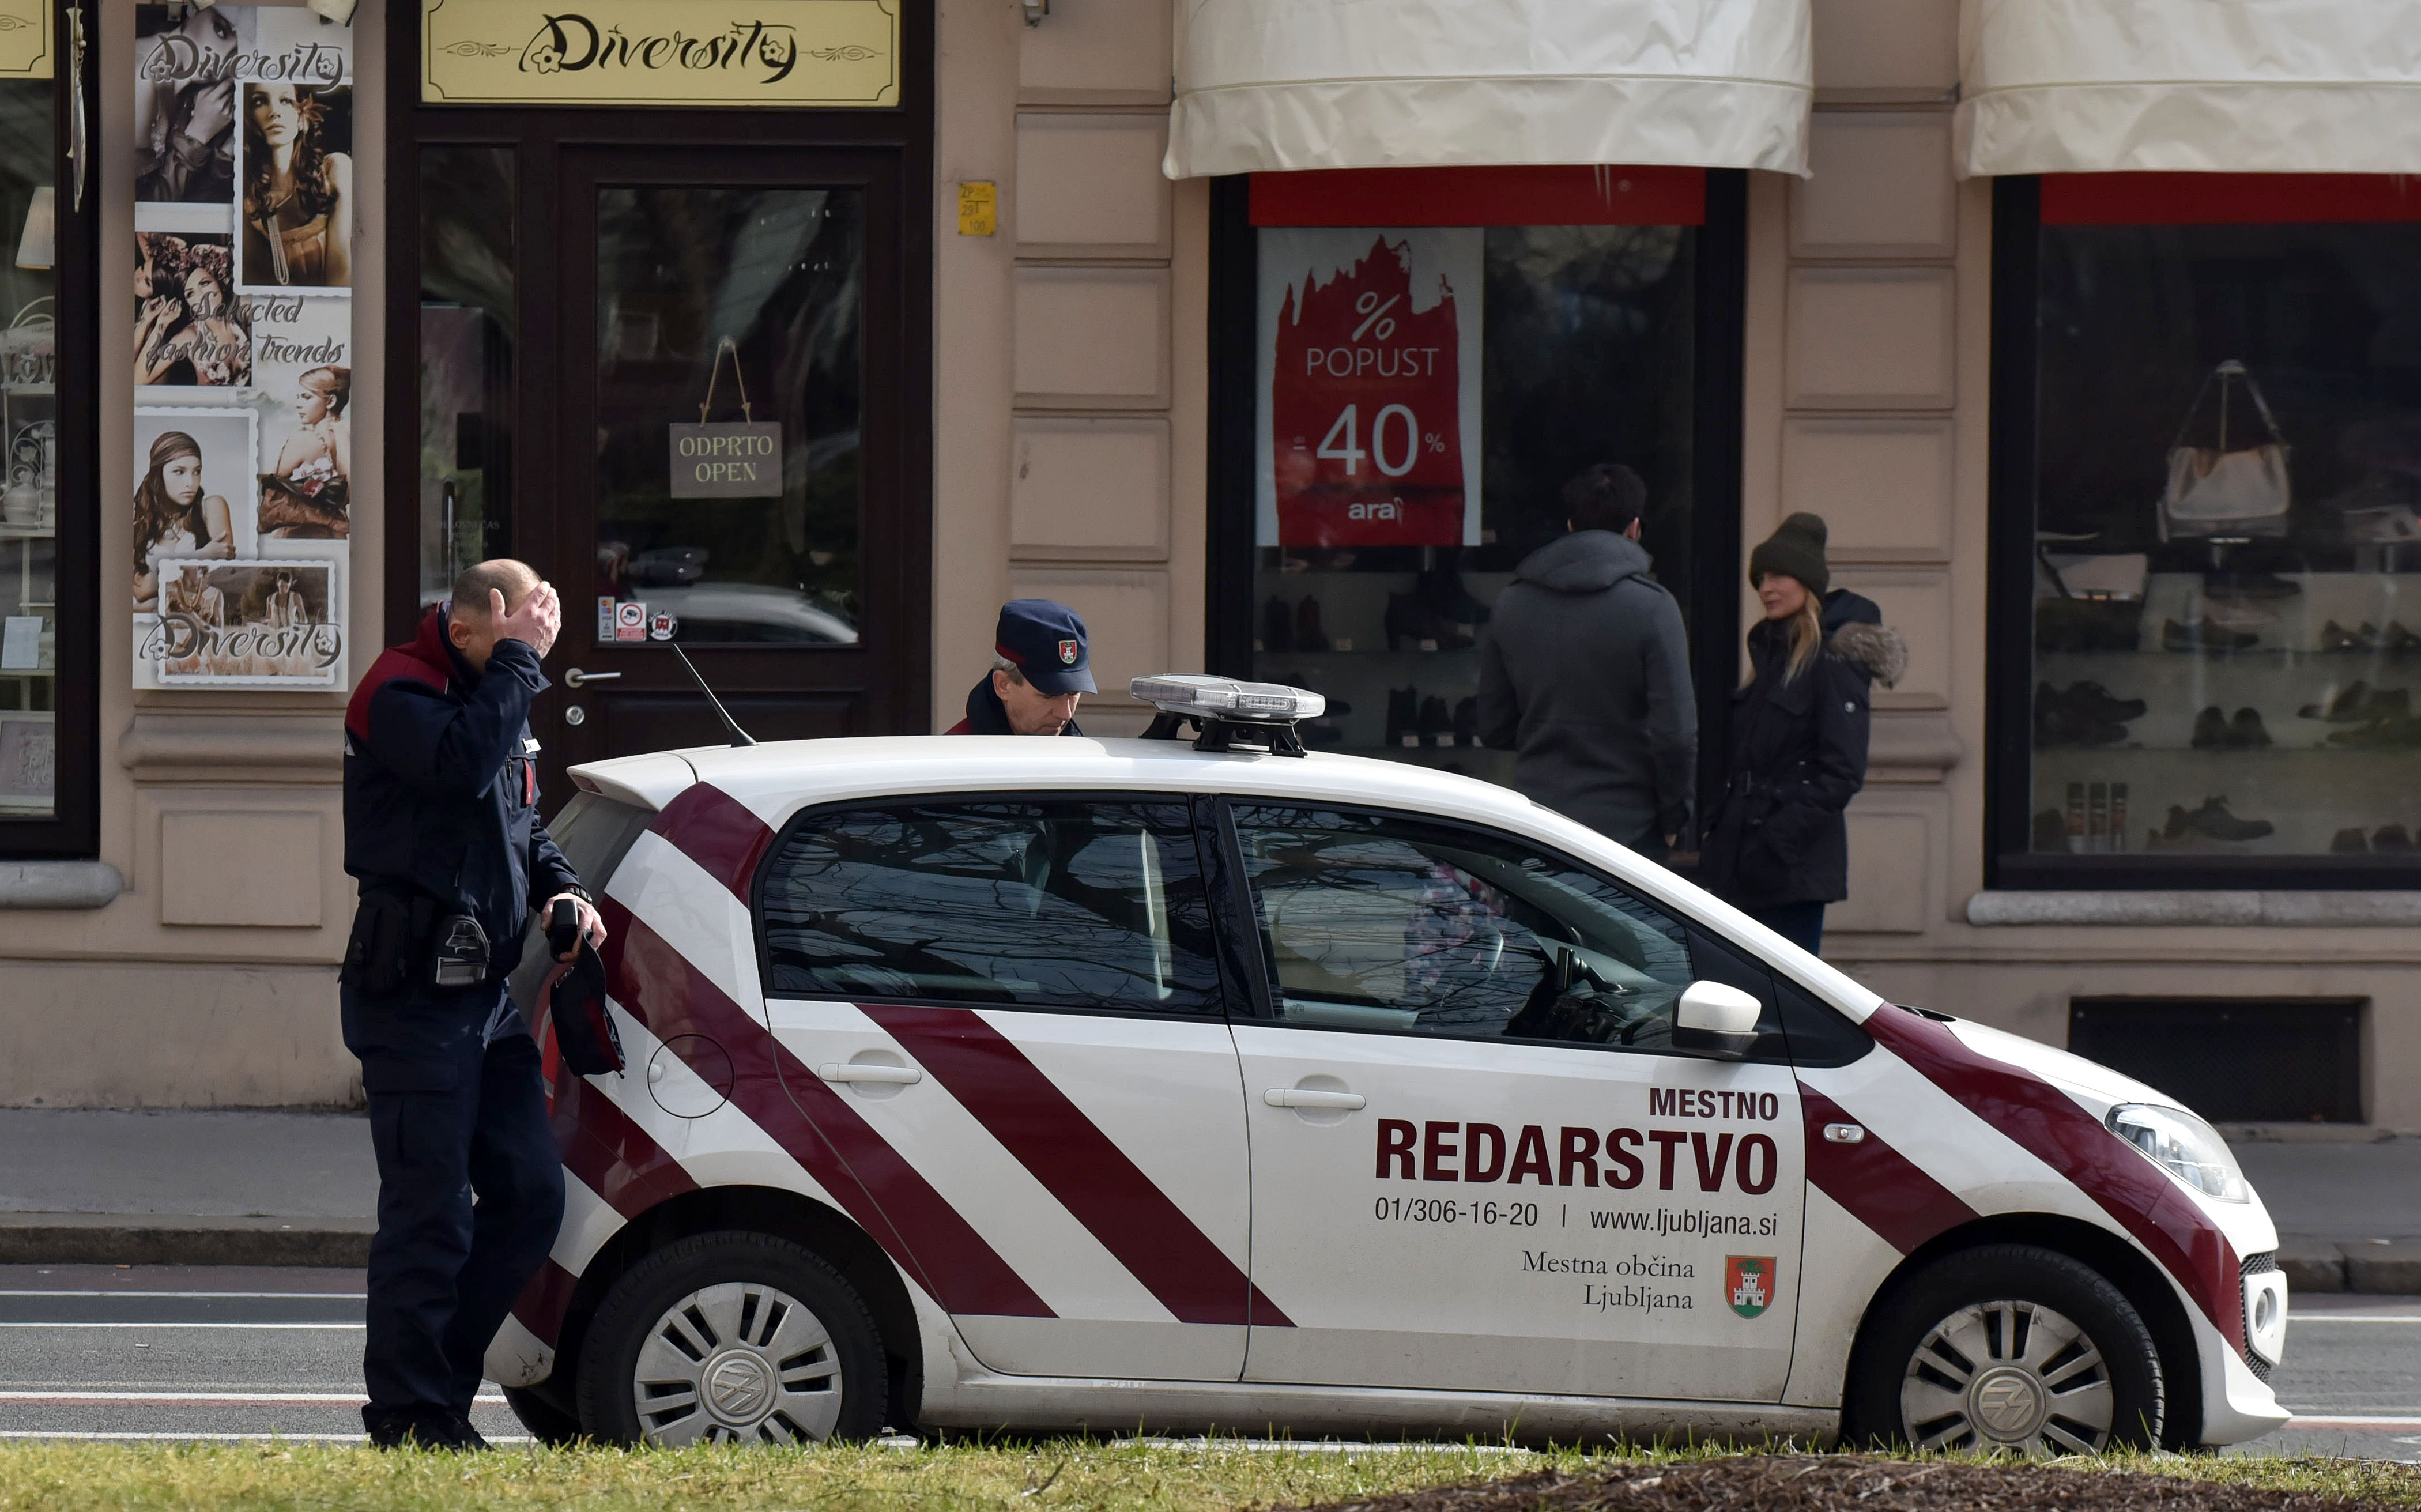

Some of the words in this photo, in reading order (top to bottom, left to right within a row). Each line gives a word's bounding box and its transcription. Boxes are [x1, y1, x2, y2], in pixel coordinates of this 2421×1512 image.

[140, 35, 344, 94] Diversity
[519, 14, 797, 84] Diversity
[189, 291, 304, 323] Selected
[256, 333, 345, 364] trends
[1306, 347, 1440, 377] POPUST
[679, 436, 773, 457] ODPRTO
[695, 462, 757, 482] OPEN
[139, 614, 342, 669] Diversity
[1649, 1088, 1778, 1121] MESTNO
[1375, 1118, 1778, 1195] REDARSTVO
[1375, 1197, 1538, 1227] 01/306-16-20
[1590, 1208, 1777, 1238] www.ljubljana.si
[1521, 1250, 1608, 1275] Mestna
[1616, 1254, 1695, 1278] občina
[1583, 1284, 1694, 1315] Ljubljana
